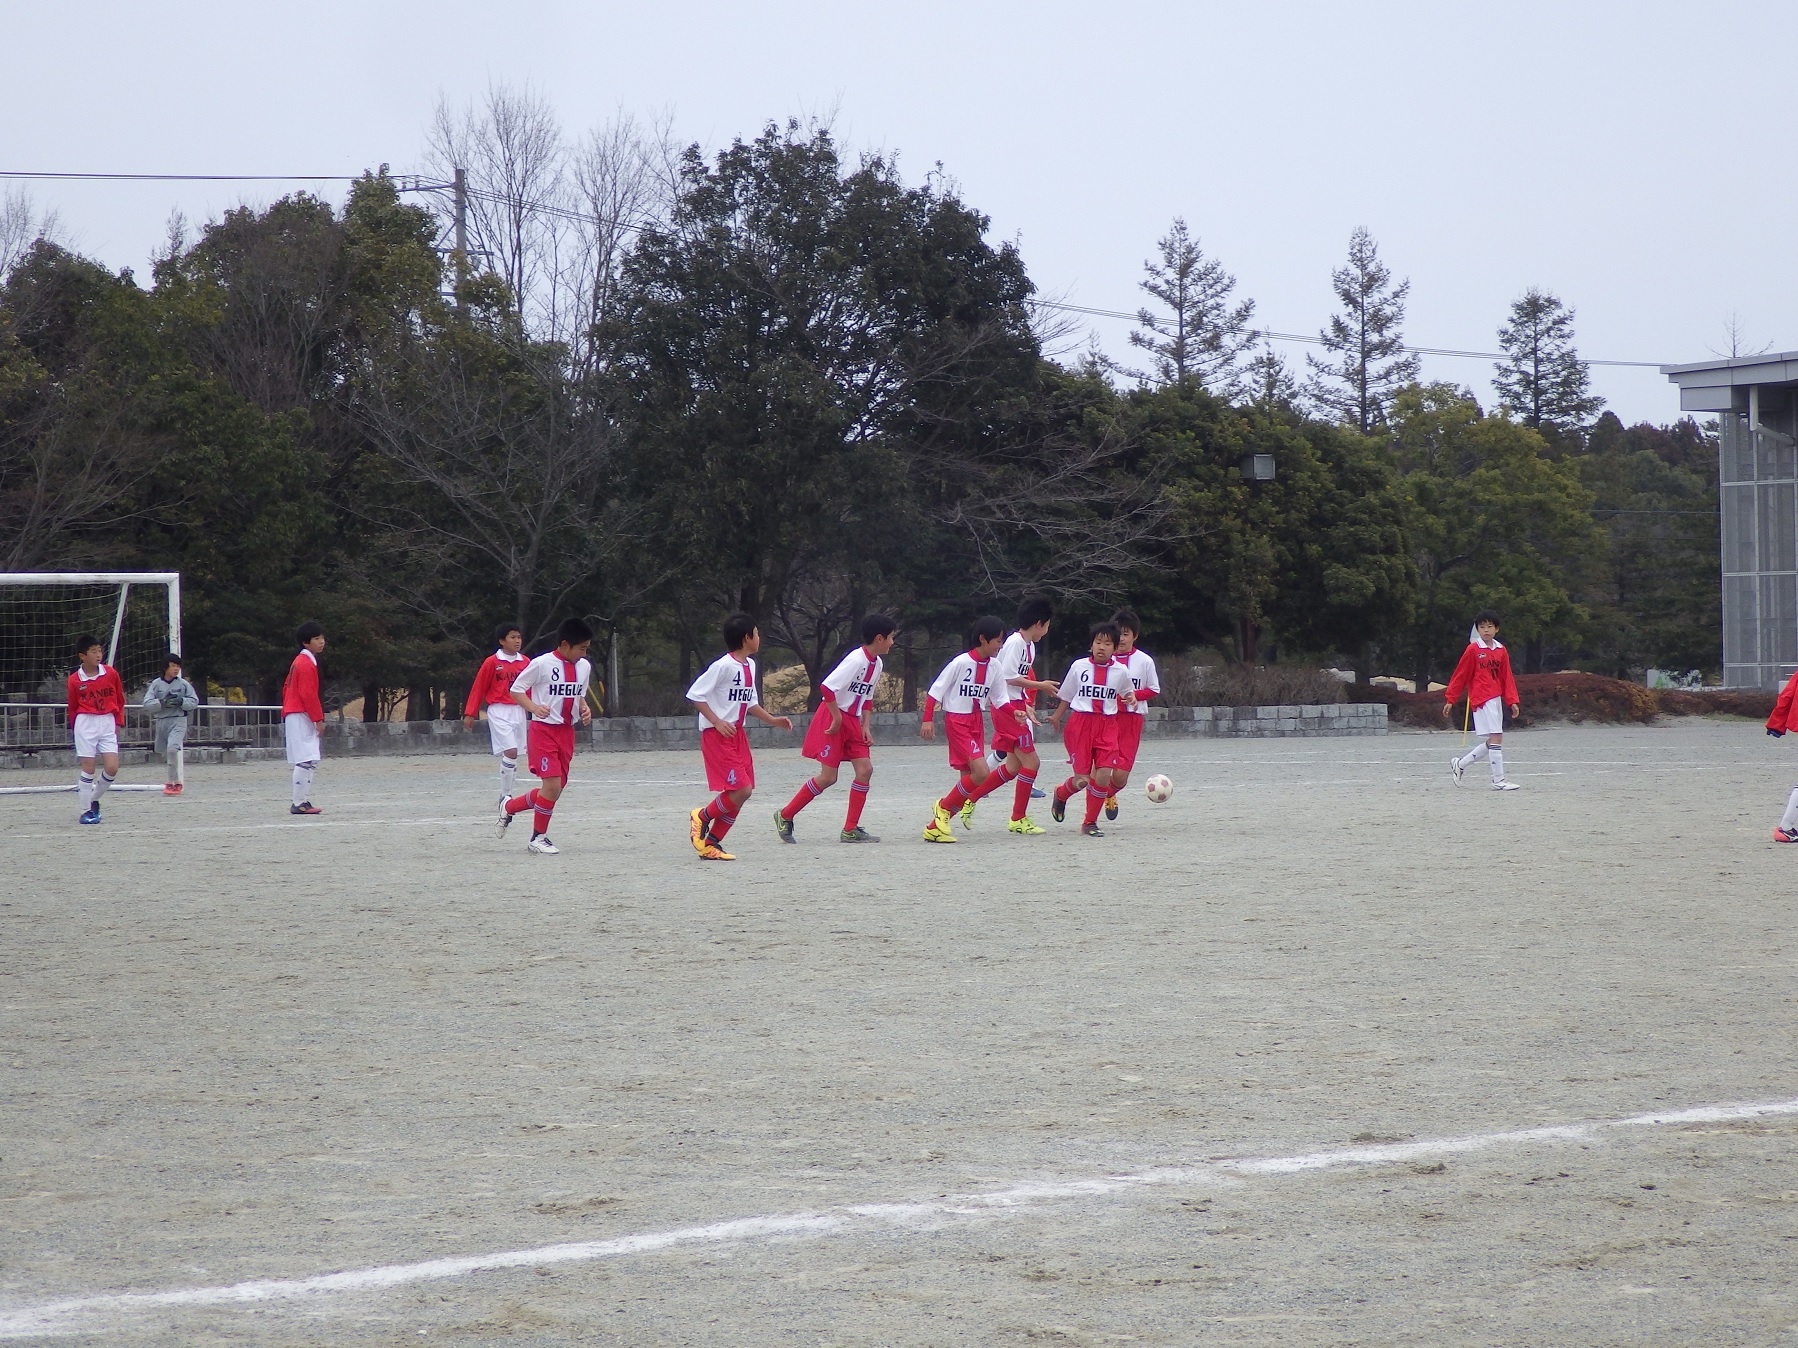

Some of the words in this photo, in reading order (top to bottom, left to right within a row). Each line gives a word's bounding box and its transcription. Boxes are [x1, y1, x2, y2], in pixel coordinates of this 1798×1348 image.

[551, 667, 560, 681] 8
[733, 670, 742, 686] 4
[963, 667, 973, 682] 2
[1080, 669, 1089, 683] 6
[80, 687, 114, 701] KANBE
[970, 740, 981, 754] 2
[1018, 734, 1031, 749] 11
[820, 744, 832, 759] 3
[541, 757, 549, 772] 8
[727, 769, 737, 785] 4
